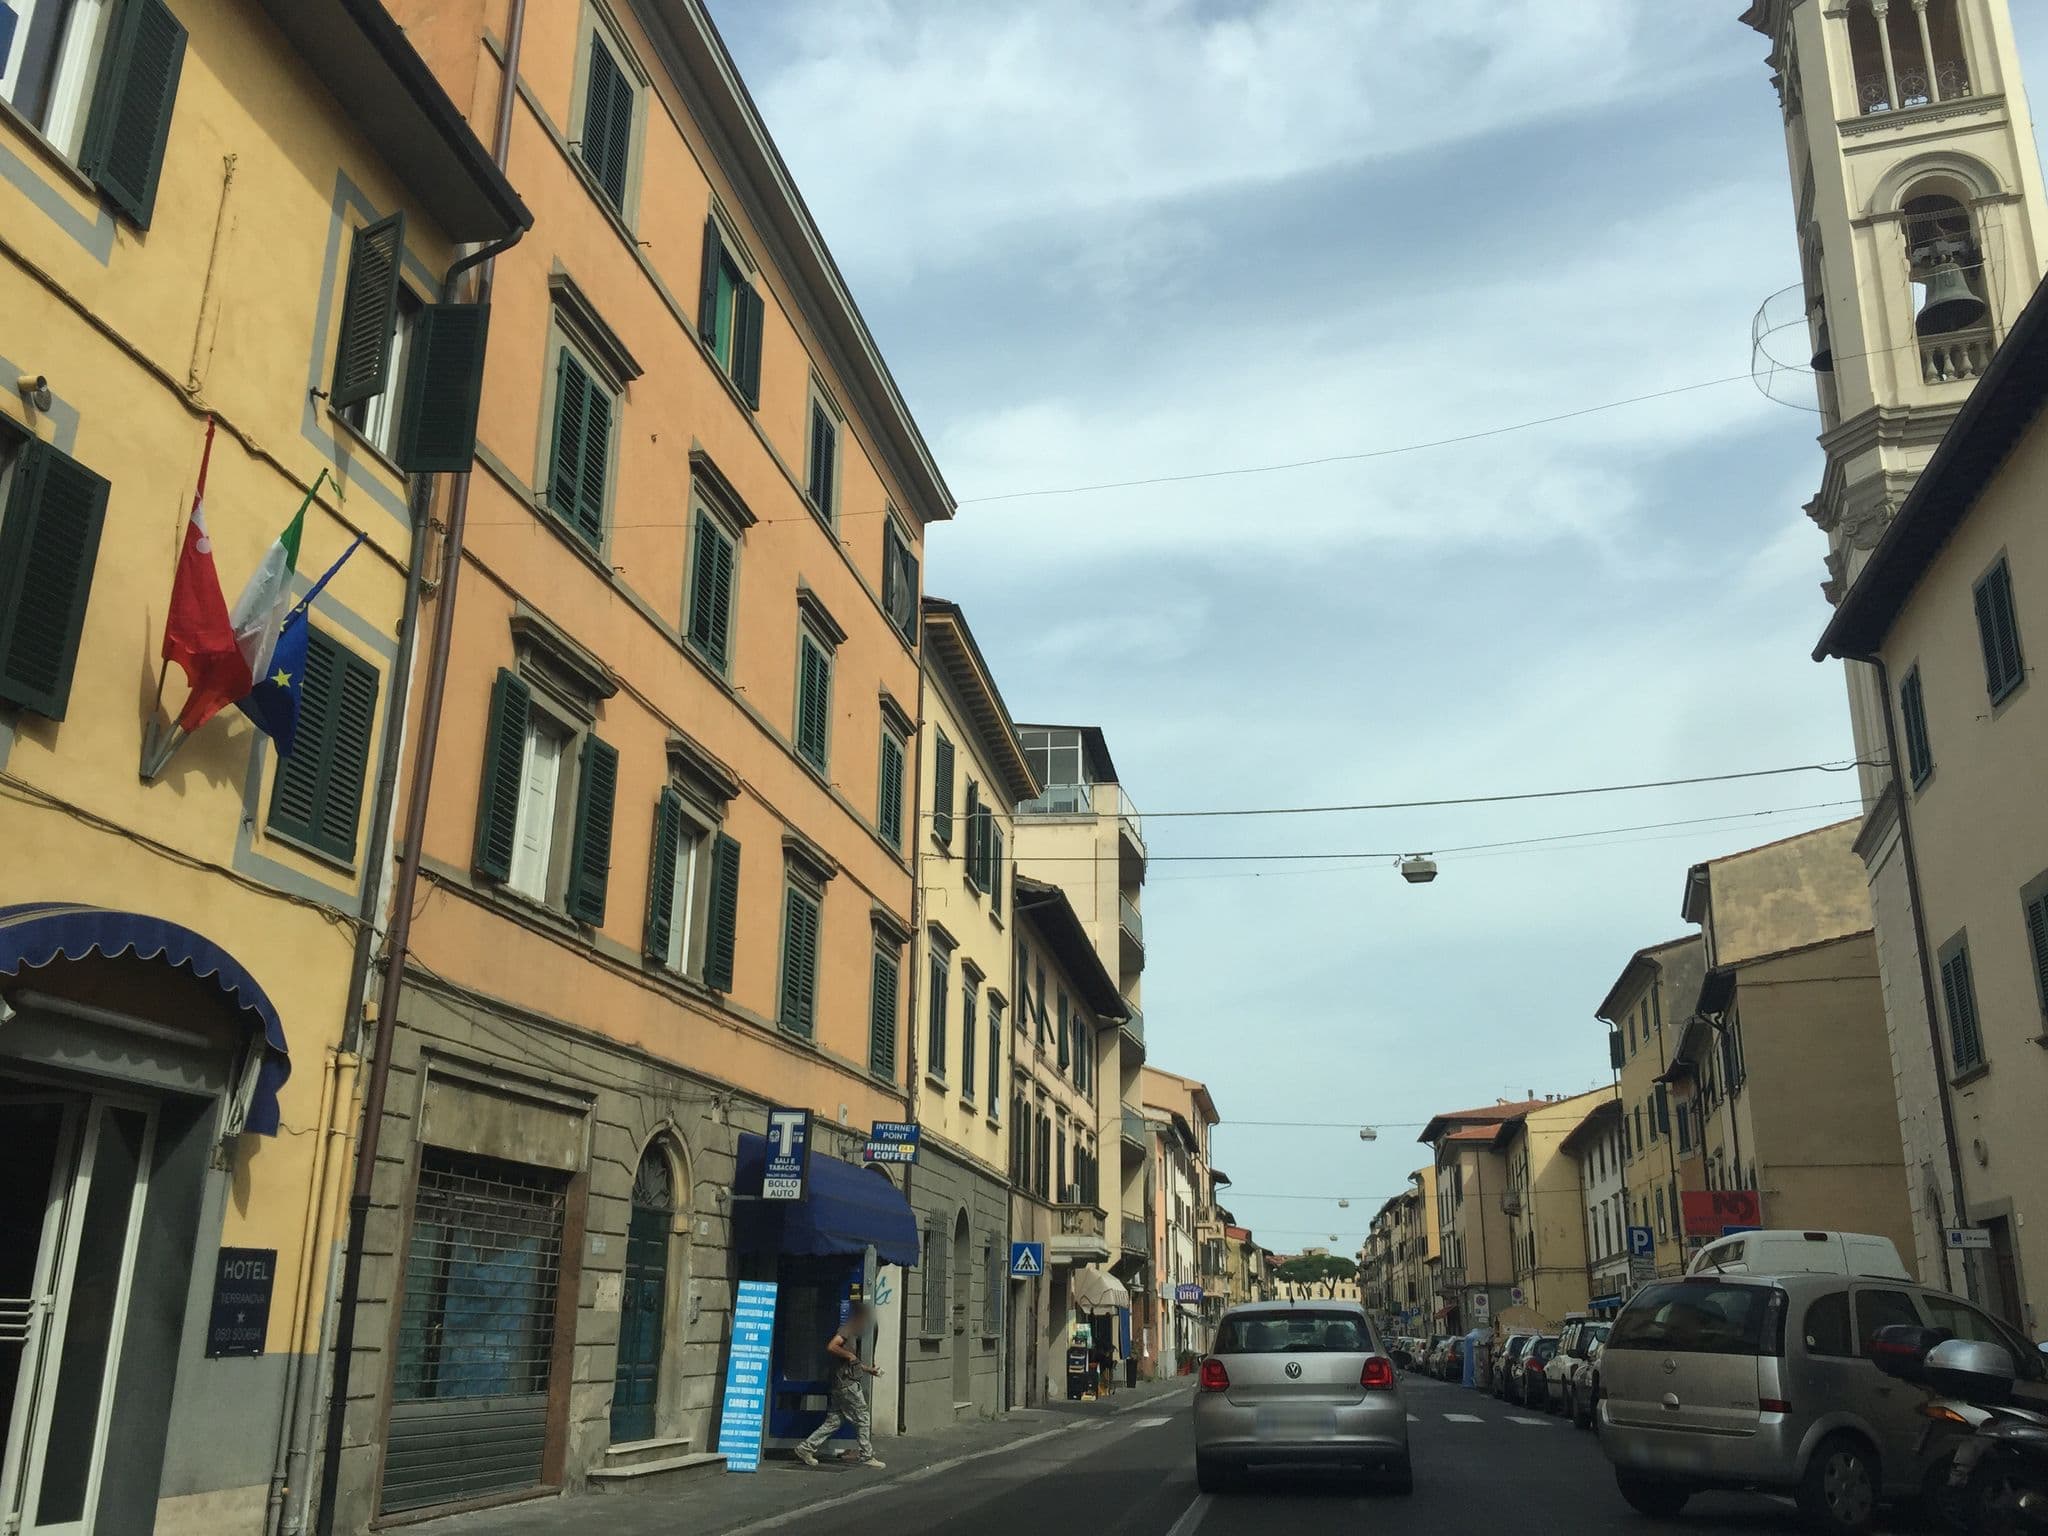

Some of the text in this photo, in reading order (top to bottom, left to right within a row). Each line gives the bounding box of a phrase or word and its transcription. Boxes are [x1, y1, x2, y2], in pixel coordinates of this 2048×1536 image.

[875, 1123, 916, 1132] INTERNET
[771, 1112, 806, 1157] T
[882, 1131, 908, 1140] POINT
[866, 1142, 899, 1152] DRINK
[873, 1151, 913, 1161] COFFEE
[768, 1164, 800, 1172] TABACCHI
[768, 1180, 798, 1188] BOLLO
[770, 1189, 795, 1197] AUTO
[1632, 1229, 1649, 1255] P
[224, 1259, 269, 1280] HOTEL
[1179, 1291, 1199, 1300] ORO
